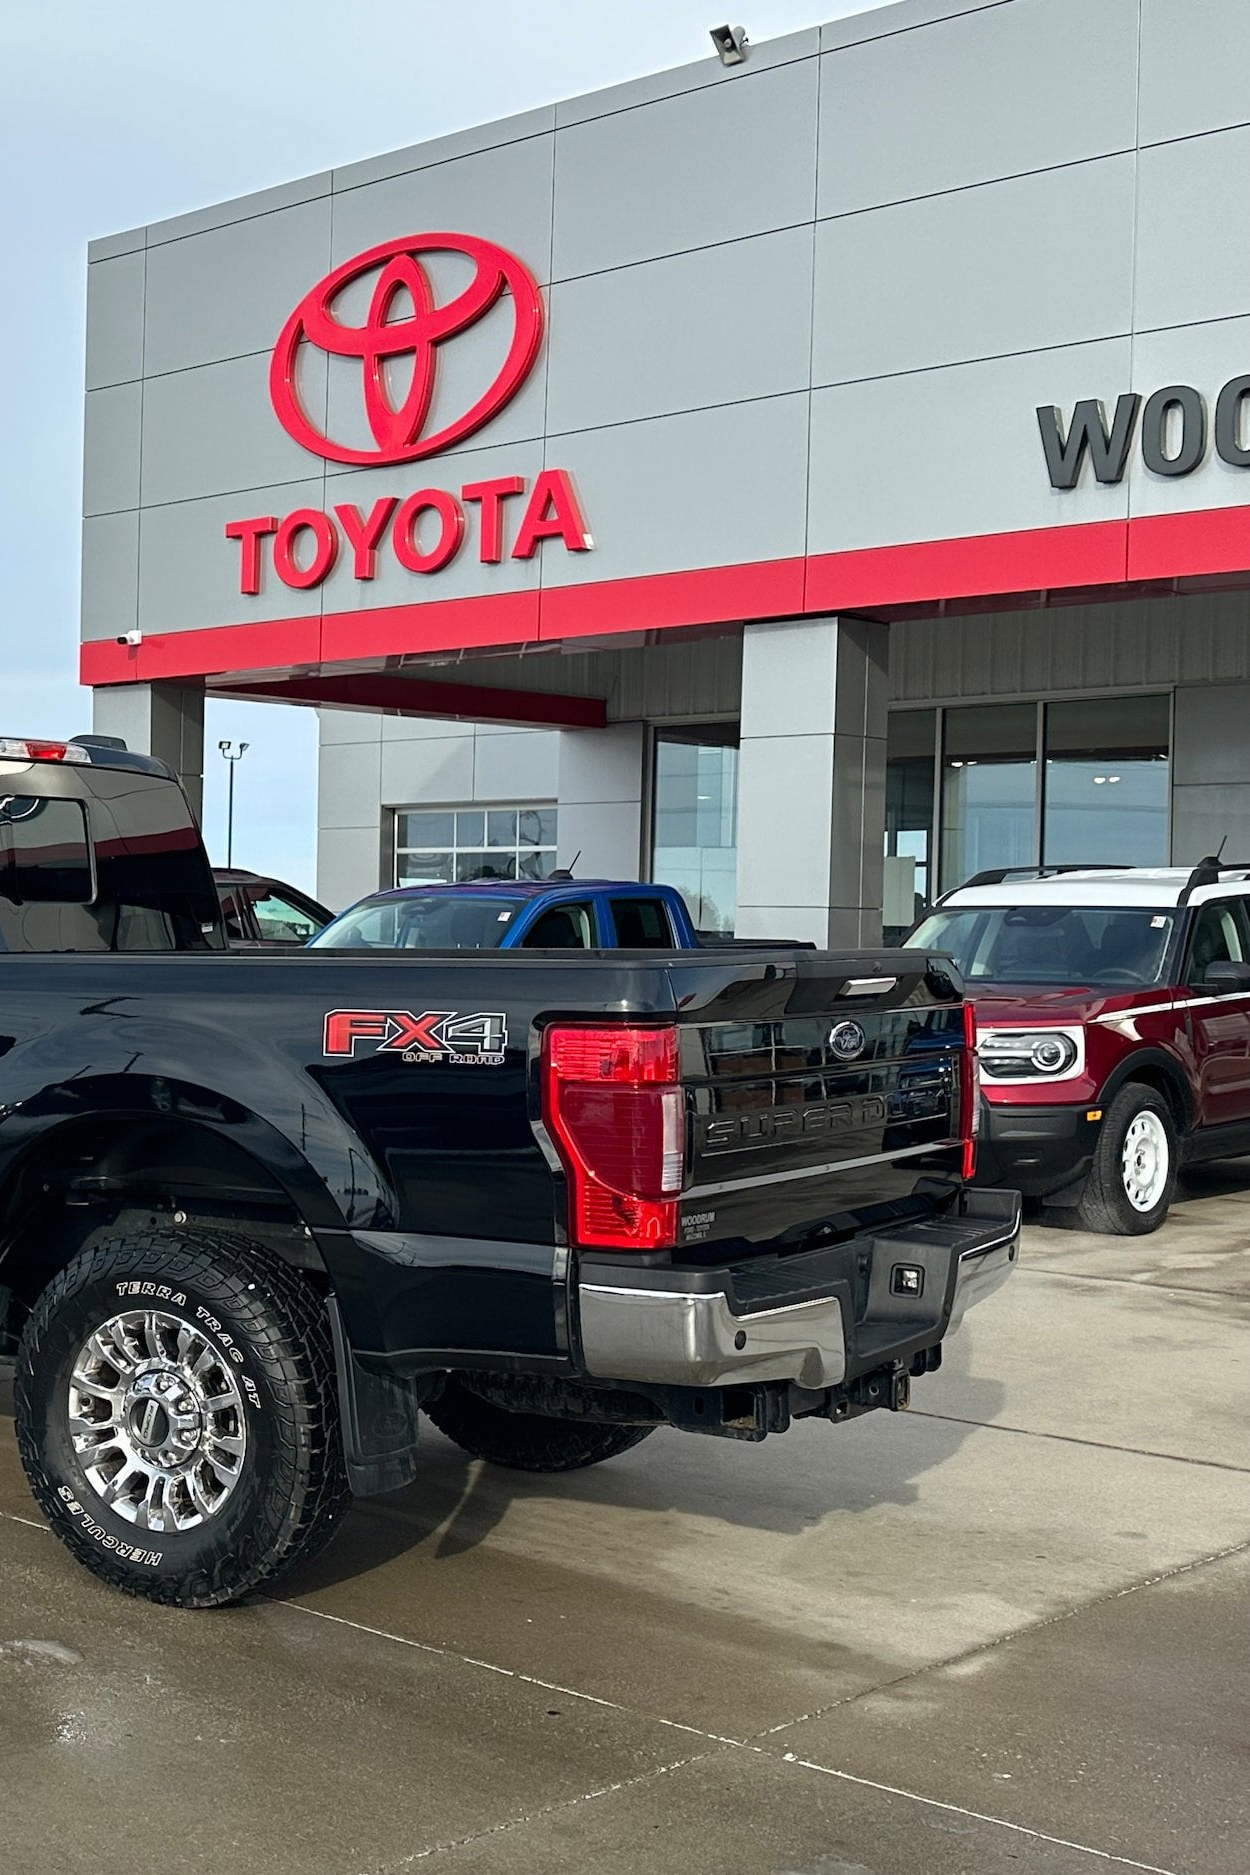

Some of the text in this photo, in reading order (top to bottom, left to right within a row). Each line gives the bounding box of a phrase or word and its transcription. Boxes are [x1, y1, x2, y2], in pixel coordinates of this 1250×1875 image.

[226, 469, 593, 596] TOYOTA
[323, 1009, 508, 1057] FX4
[402, 1051, 505, 1065] OFF ROAD
[706, 1100, 854, 1144] SUPER
[116, 1281, 262, 1410] TERRA TRAC AT
[56, 1485, 164, 1567] HERCULES
